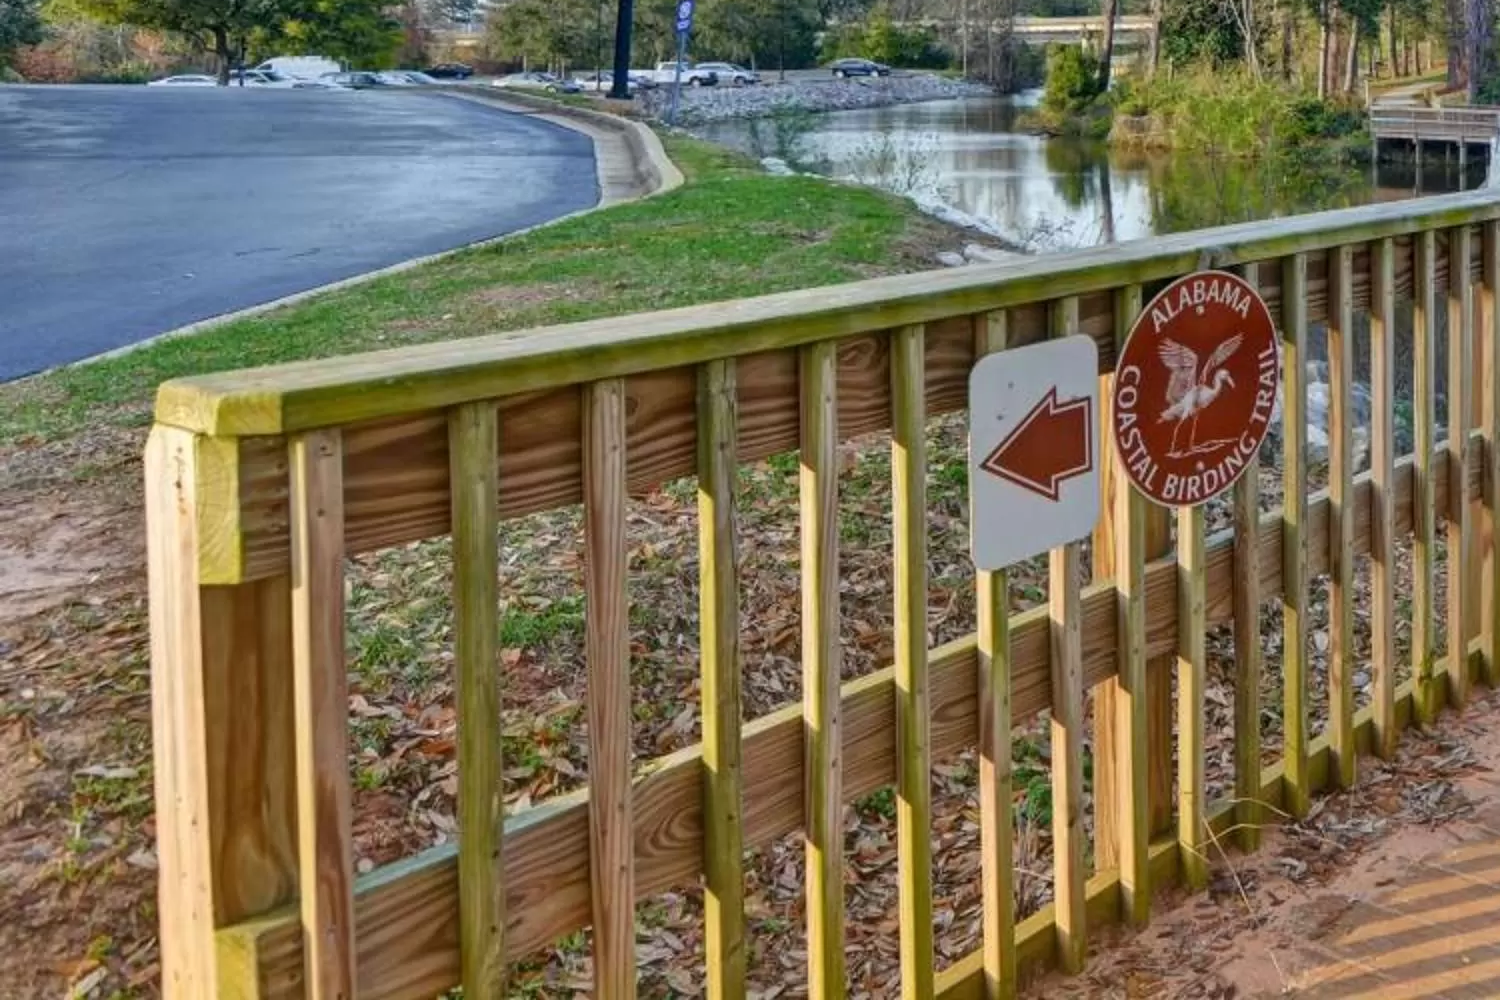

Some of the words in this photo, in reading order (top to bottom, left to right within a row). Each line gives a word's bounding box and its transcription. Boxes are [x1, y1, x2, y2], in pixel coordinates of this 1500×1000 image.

[1151, 279, 1252, 333] ALABAMA
[1117, 365, 1159, 491] COASTAL
[1162, 430, 1257, 500] BIRDING
[1249, 339, 1275, 423] TRAIL
